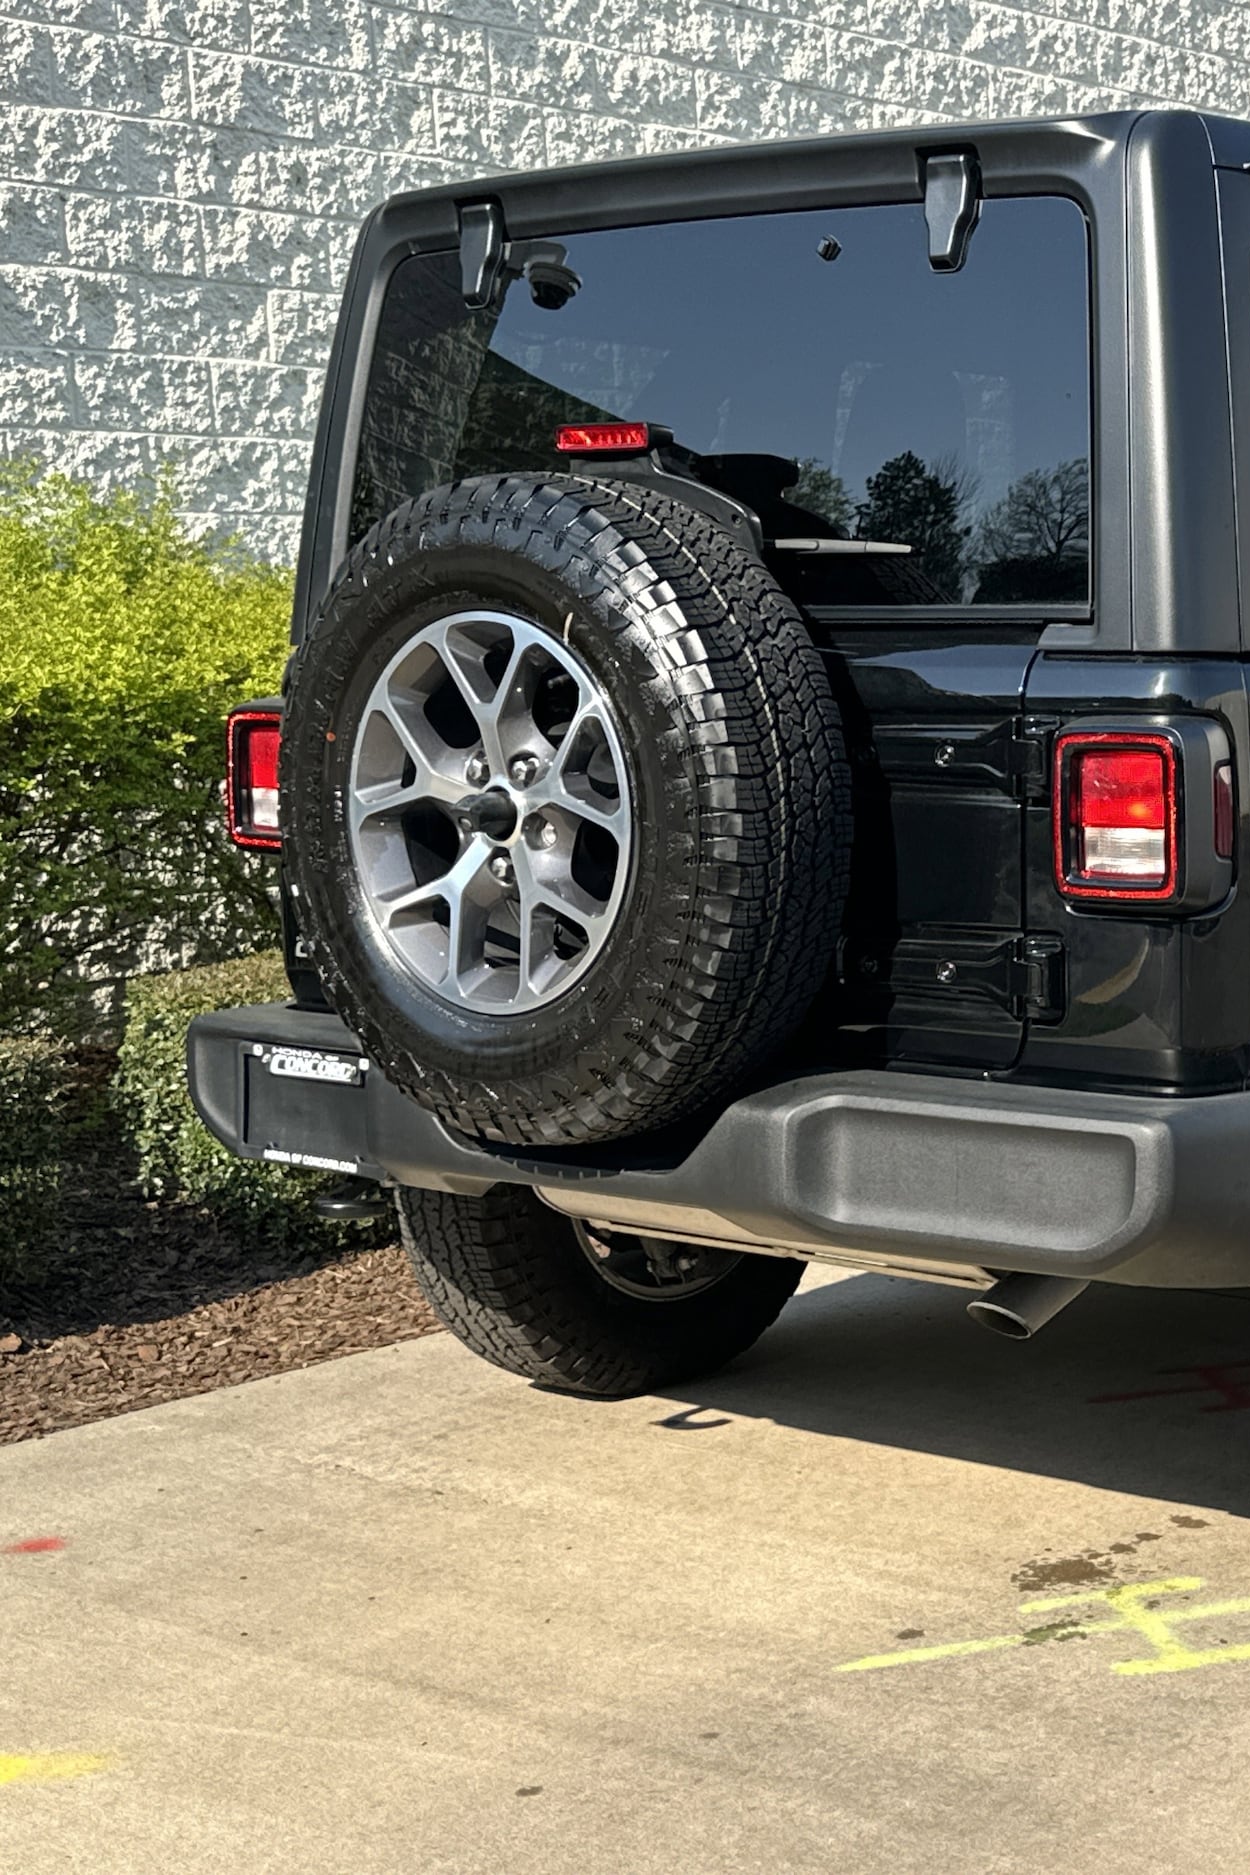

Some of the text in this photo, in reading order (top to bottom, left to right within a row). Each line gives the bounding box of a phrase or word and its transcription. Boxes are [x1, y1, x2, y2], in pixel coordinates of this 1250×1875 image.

[271, 1046, 323, 1060] HONDA
[270, 1054, 356, 1081] CONCORD
[263, 1148, 291, 1162] HONDA
